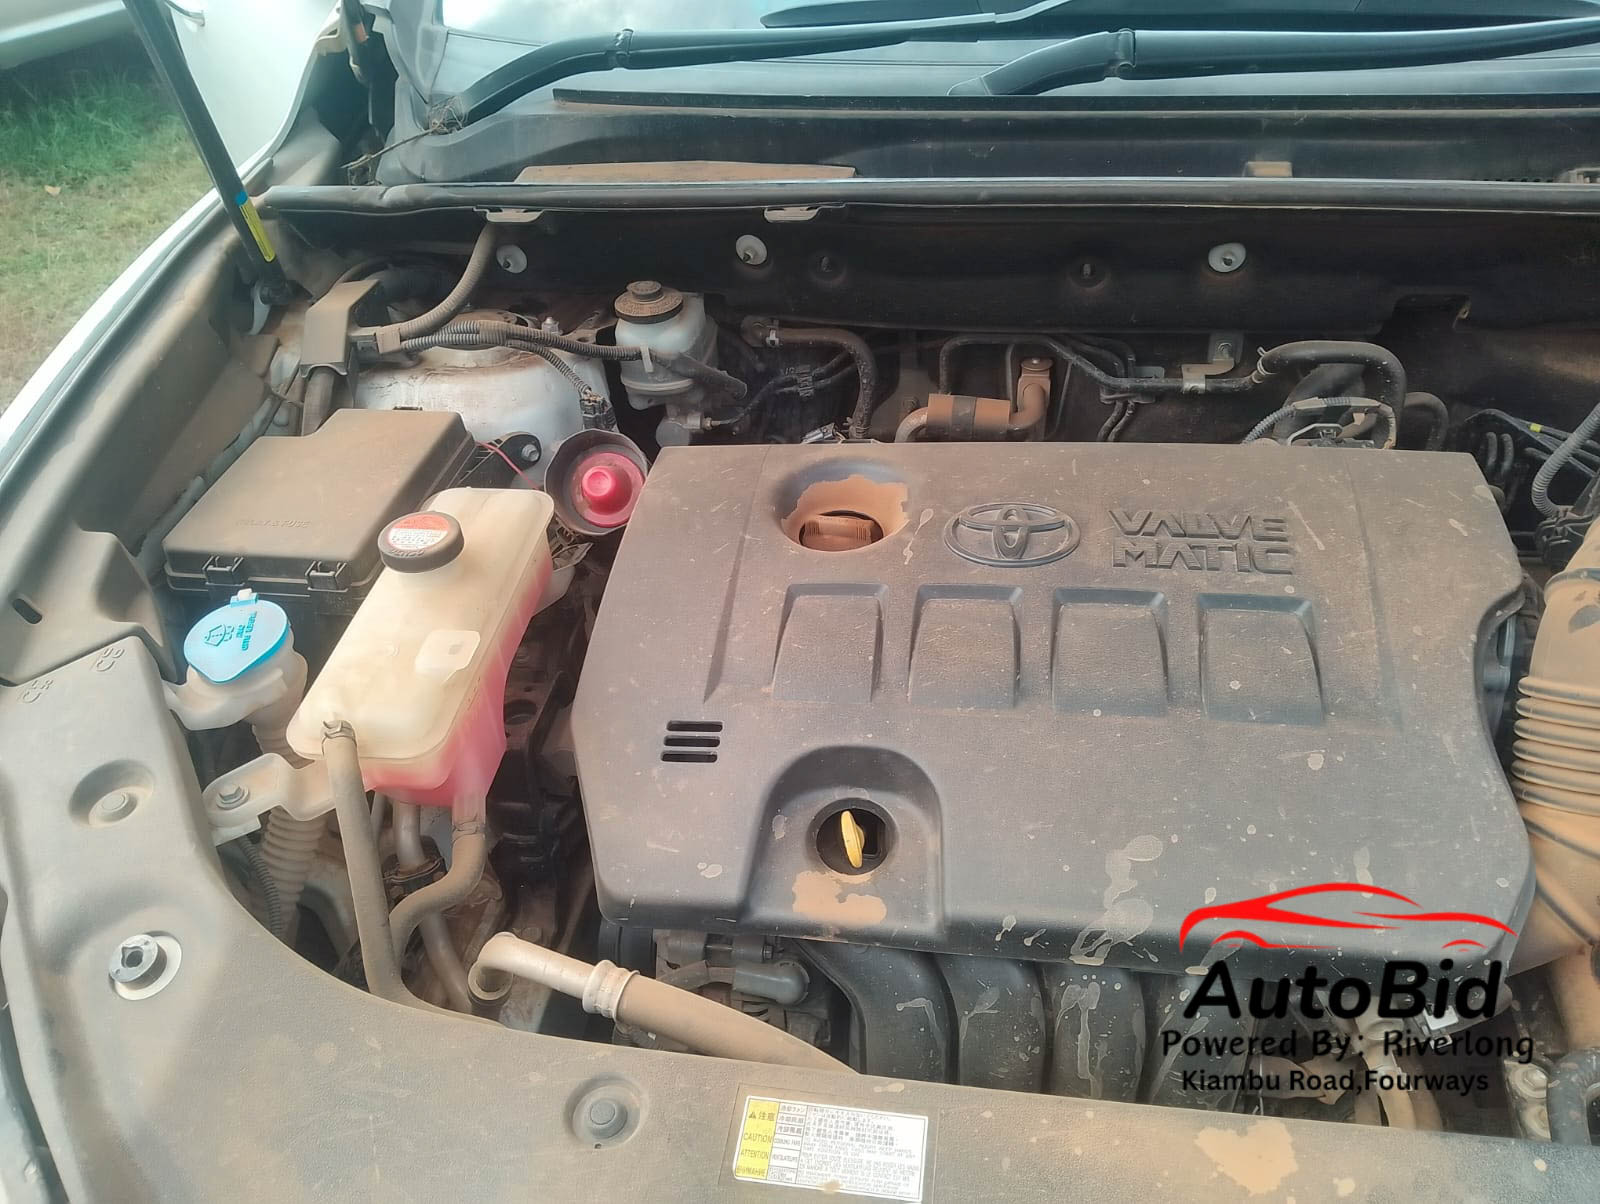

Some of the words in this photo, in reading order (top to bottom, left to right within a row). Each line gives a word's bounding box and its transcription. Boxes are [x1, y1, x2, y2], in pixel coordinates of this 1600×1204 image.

[1108, 510, 1288, 542] VALVE
[1112, 541, 1293, 575] MATIC
[743, 1132, 773, 1144] CAUTION
[740, 1148, 769, 1160] ATTENTION
